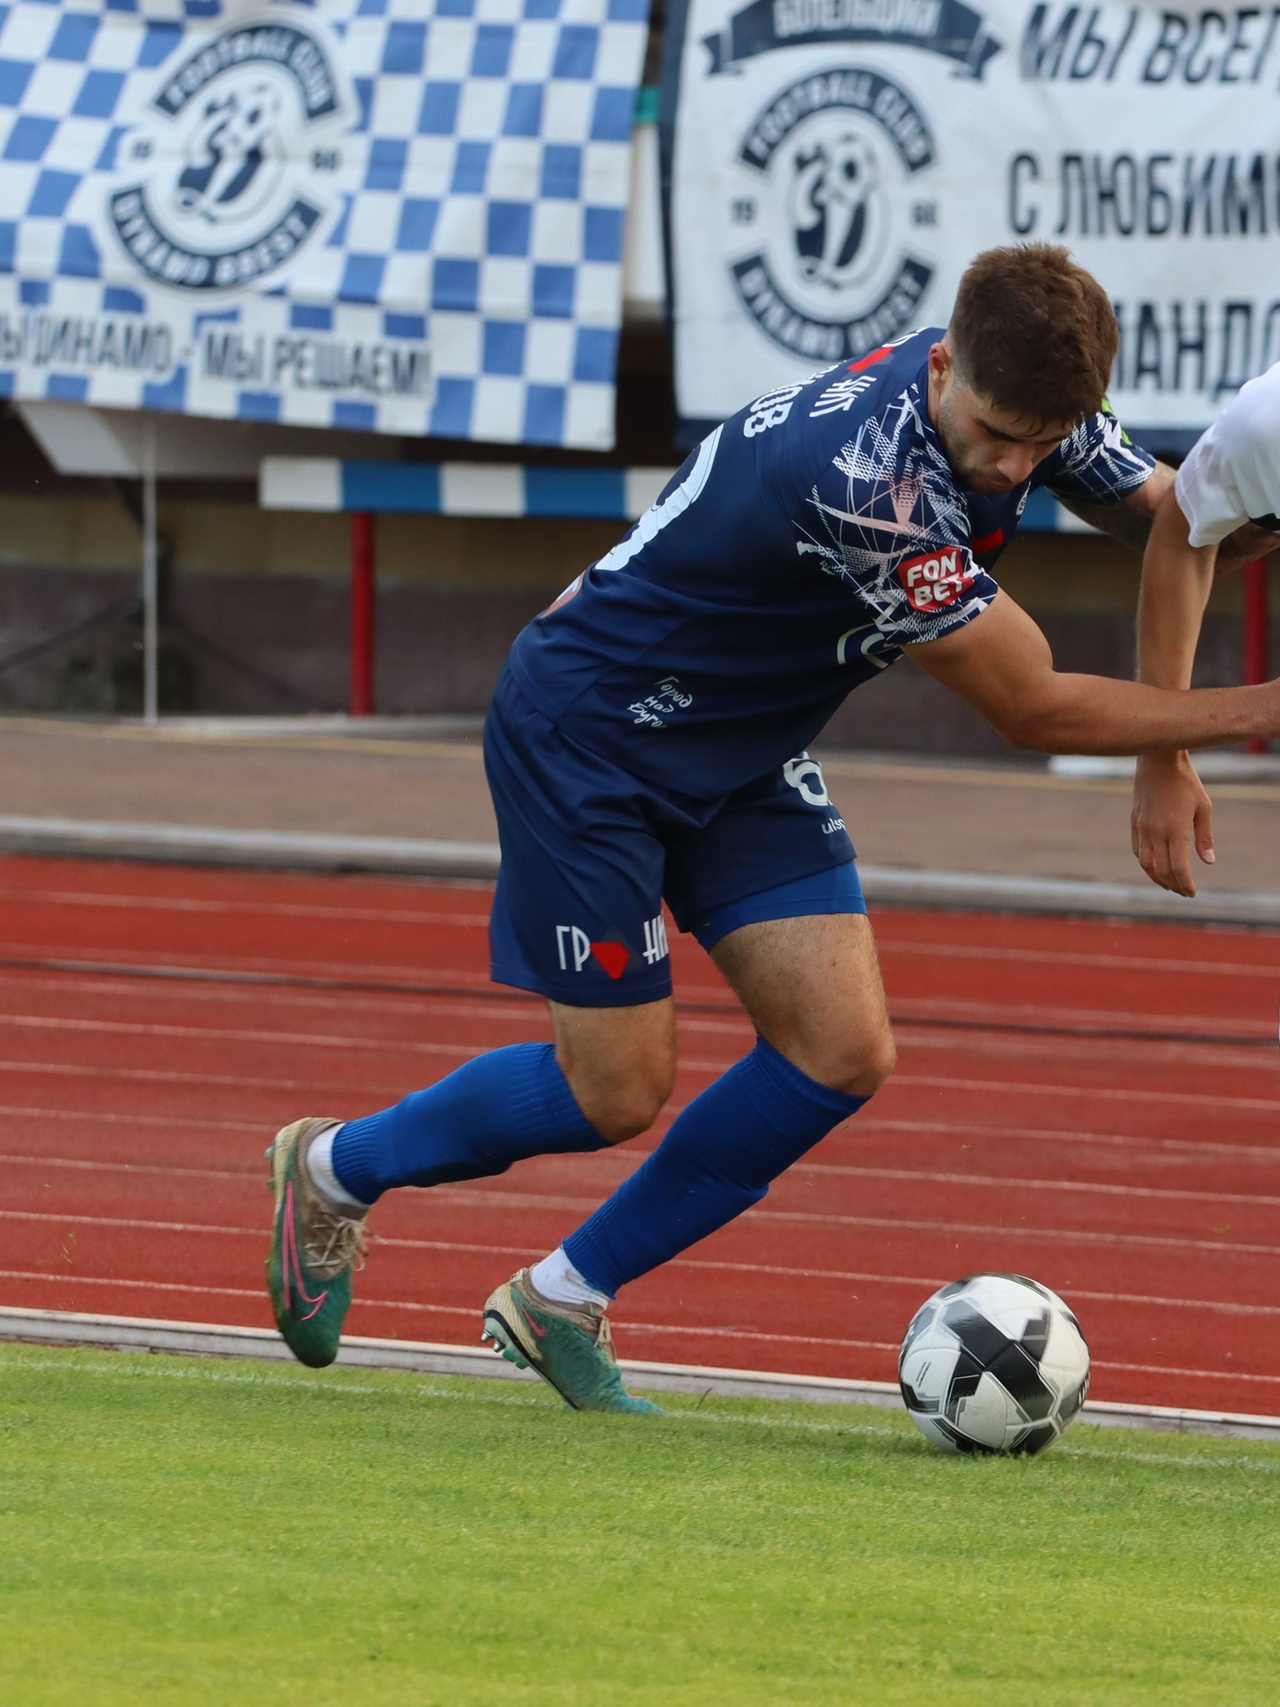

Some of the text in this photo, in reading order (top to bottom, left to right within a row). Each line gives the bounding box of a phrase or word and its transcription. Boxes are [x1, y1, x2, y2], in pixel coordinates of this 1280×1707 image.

[1021, 3, 1138, 82] МЫ
[749, 72, 873, 161] FOOTBALL
[1010, 154, 1039, 235] С
[33, 316, 174, 375] ДИНАМО
[907, 551, 957, 587] FON
[914, 573, 963, 607] BET
[627, 702, 667, 728] Буго
[654, 676, 693, 708] Город
